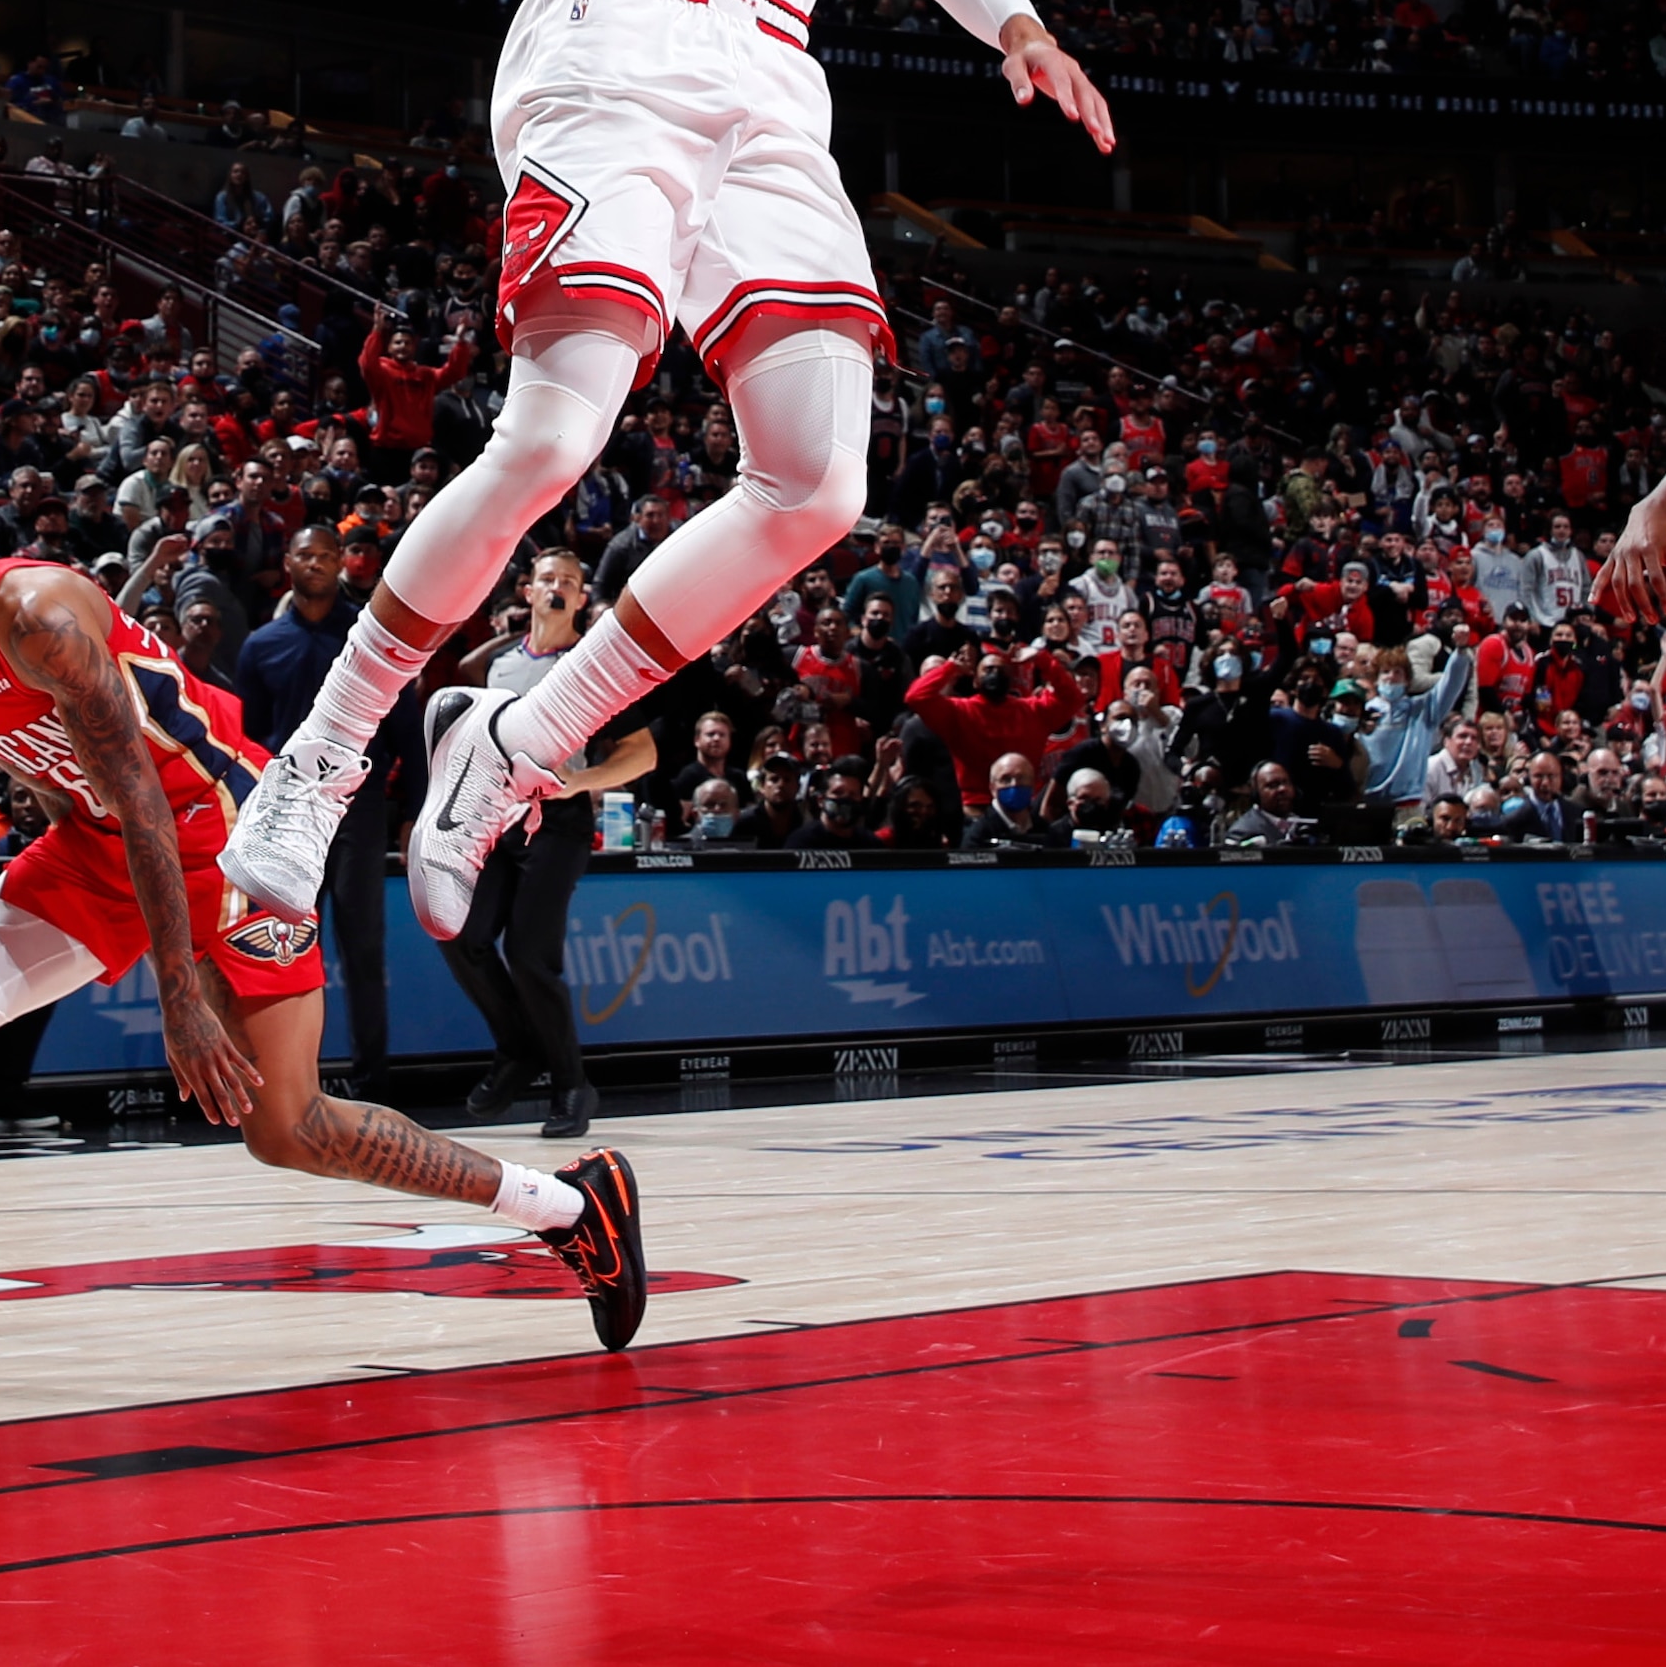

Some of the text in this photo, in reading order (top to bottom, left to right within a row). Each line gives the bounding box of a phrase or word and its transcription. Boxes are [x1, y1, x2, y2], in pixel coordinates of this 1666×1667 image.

[1556, 587, 1574, 607] 51
[636, 854, 694, 869] ZENNI.COM
[1536, 882, 1623, 925] FREE
[823, 894, 912, 977] Abt
[1101, 900, 1298, 982] Whirlpool
[927, 935, 1045, 968] Abt.com
[1497, 1016, 1544, 1031] ZENNI.COM
[1128, 1032, 1184, 1055] ZENNI
[679, 1055, 731, 1071] EYEWEAR
[834, 1047, 899, 1072] ZENNI
